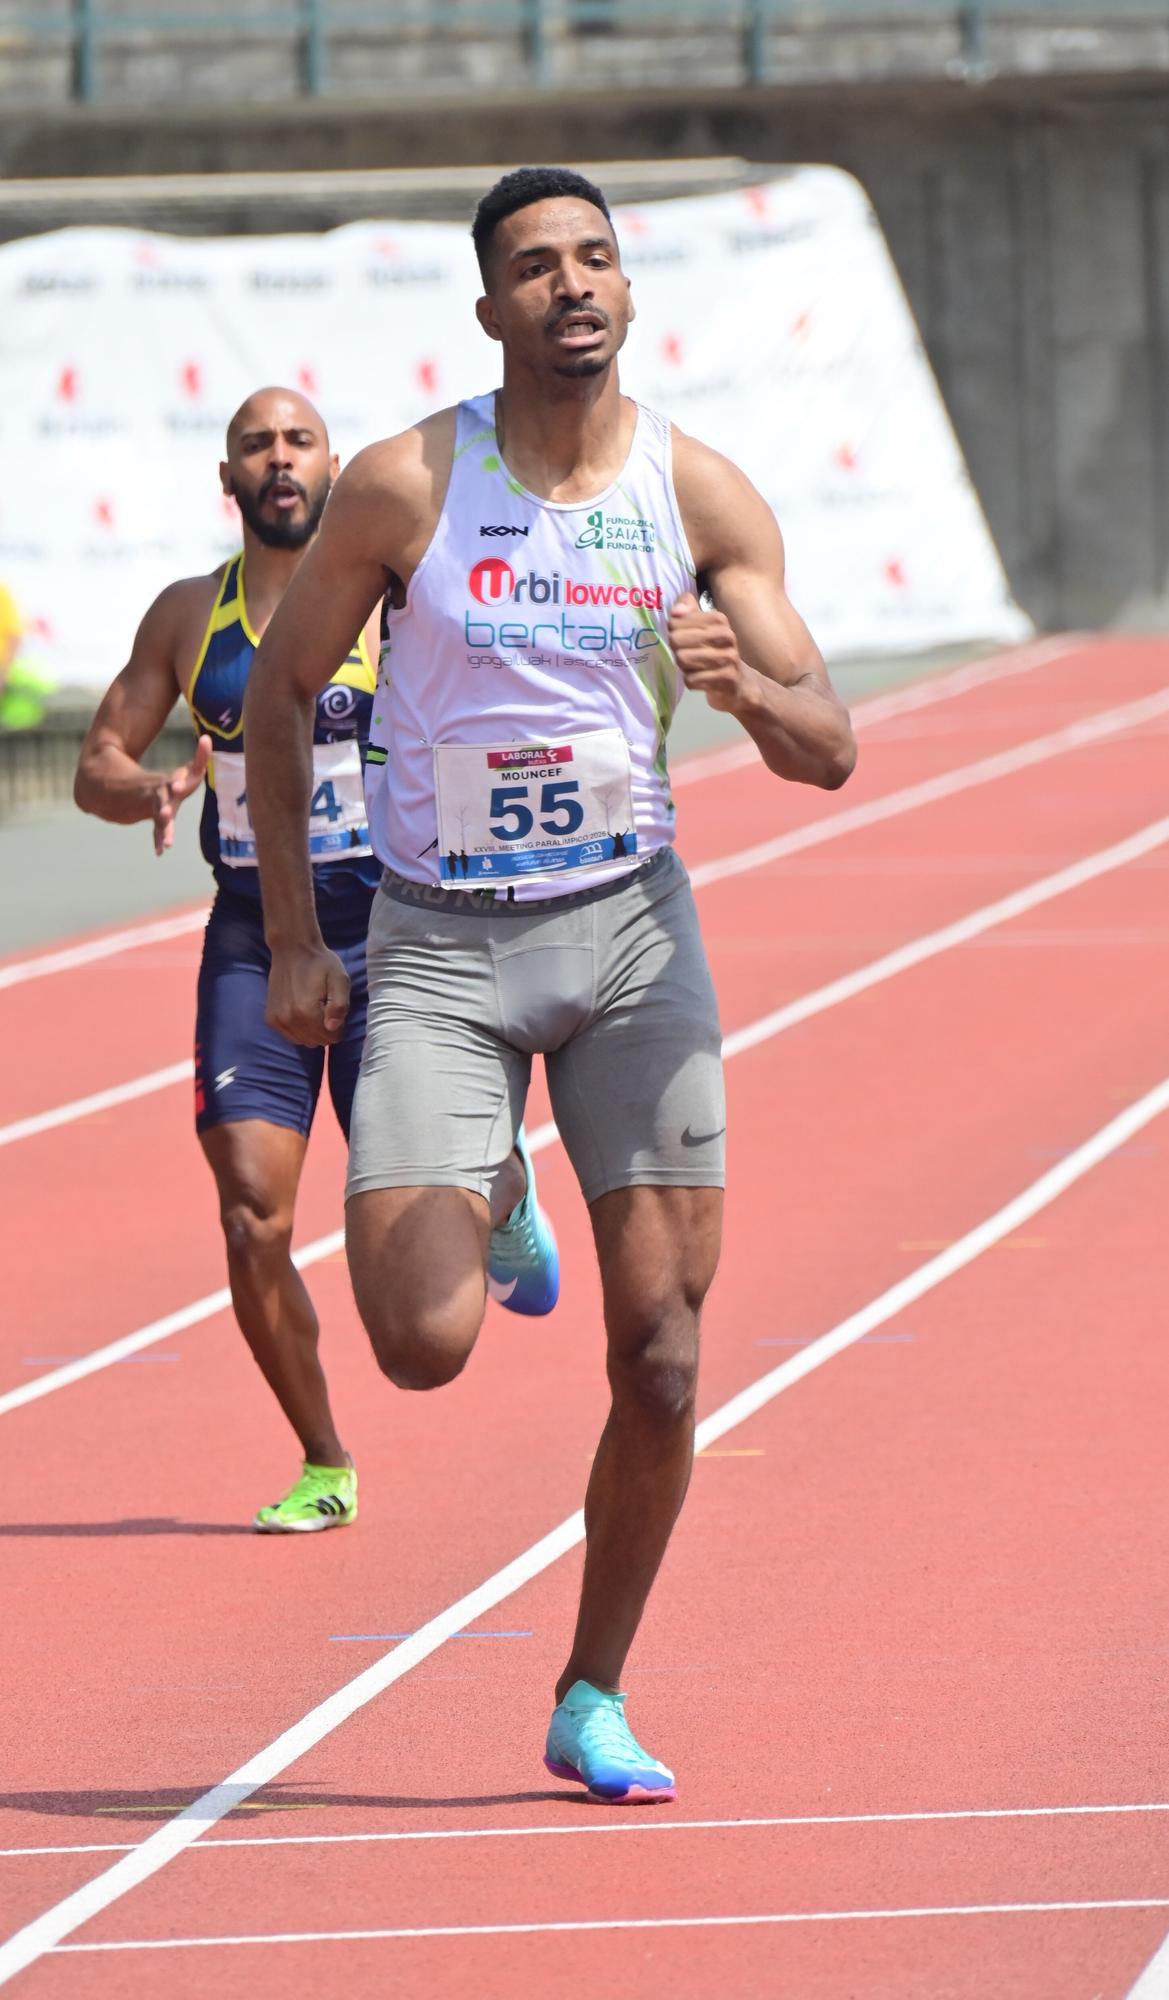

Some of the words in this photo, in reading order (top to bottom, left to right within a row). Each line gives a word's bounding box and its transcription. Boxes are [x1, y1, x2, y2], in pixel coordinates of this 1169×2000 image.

[478, 568, 559, 606] Urbi
[566, 580, 663, 611] lowcost
[465, 610, 661, 651] bertako
[501, 751, 546, 761] LABORAL
[501, 768, 562, 781] MOUNCEF
[488, 780, 584, 841] 55
[498, 841, 534, 852] MEETING
